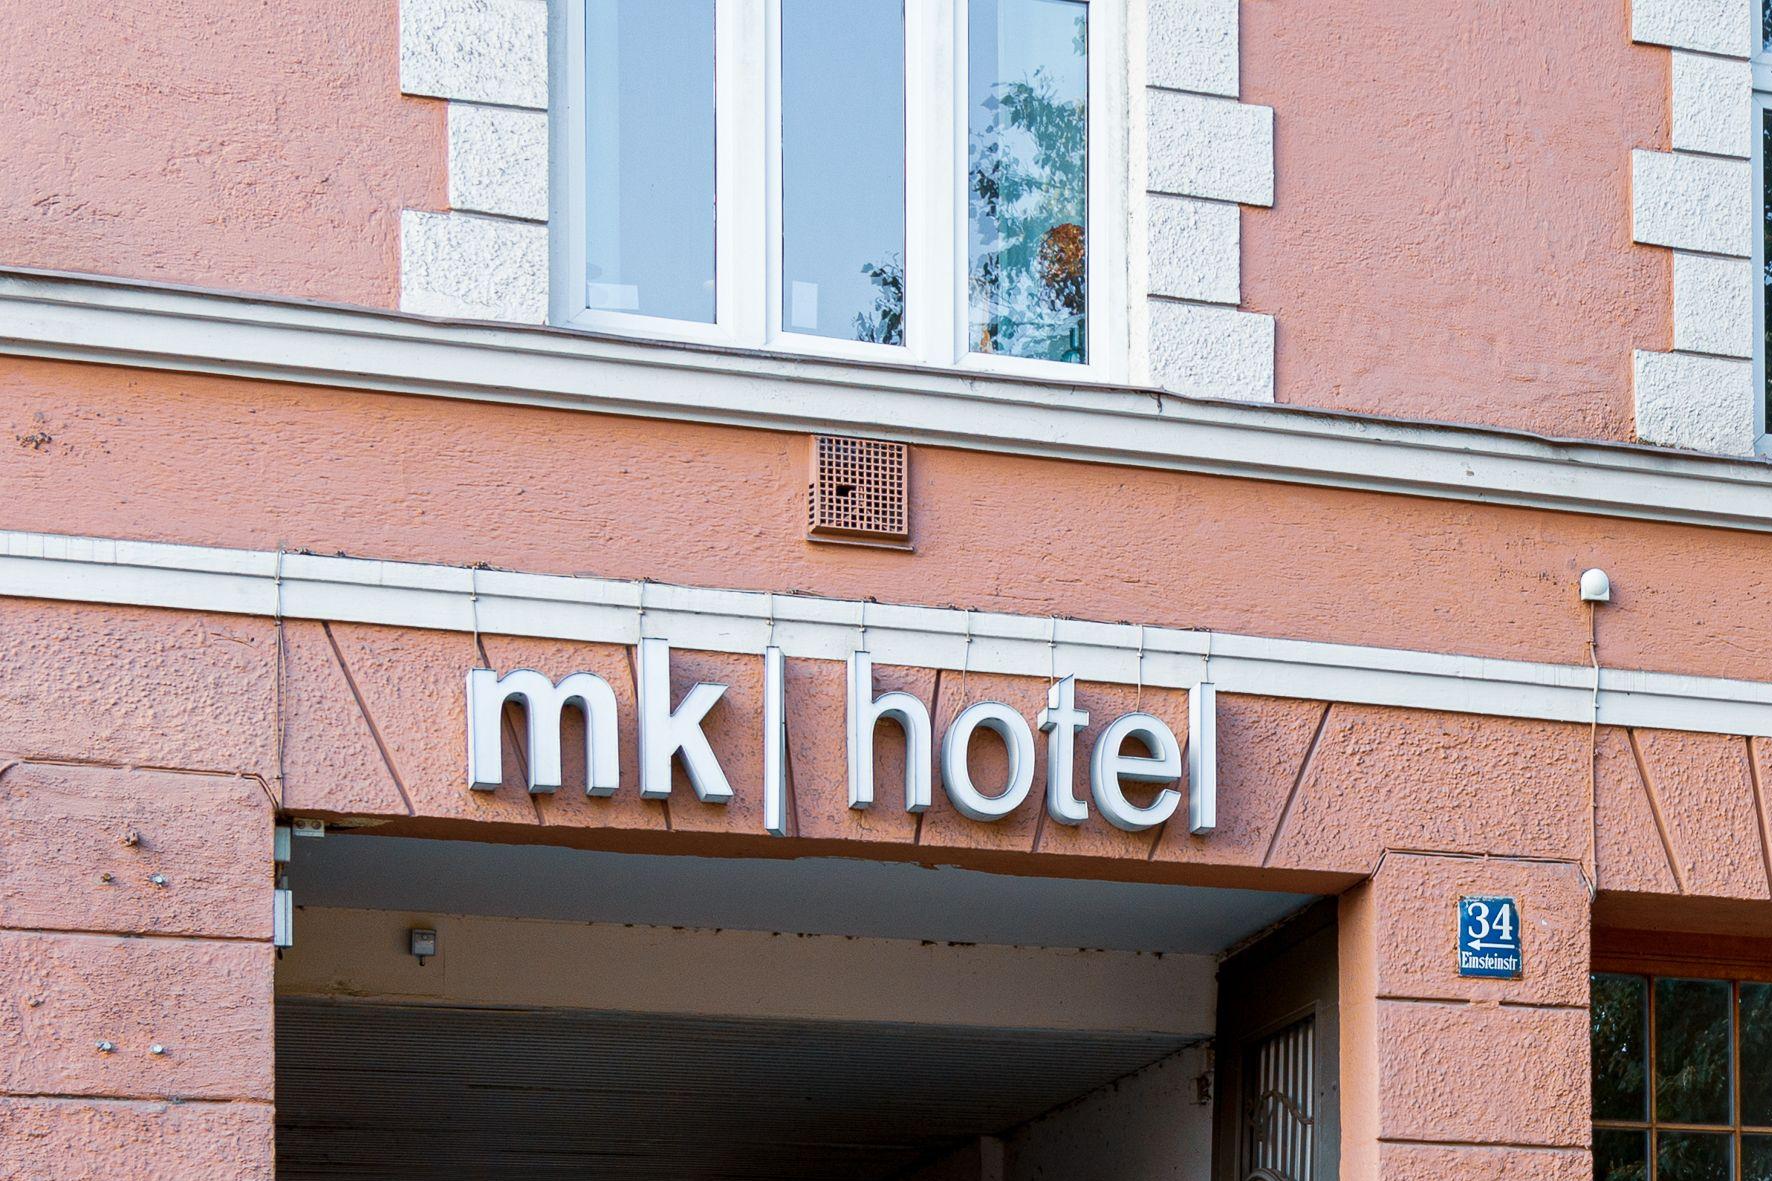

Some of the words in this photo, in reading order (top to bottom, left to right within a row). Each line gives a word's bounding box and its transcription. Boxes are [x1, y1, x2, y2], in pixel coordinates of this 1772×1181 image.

[466, 637, 734, 804] mk
[846, 650, 1216, 835] hotel
[1467, 902, 1513, 940] 34
[1461, 951, 1518, 971] Einsteinstr
